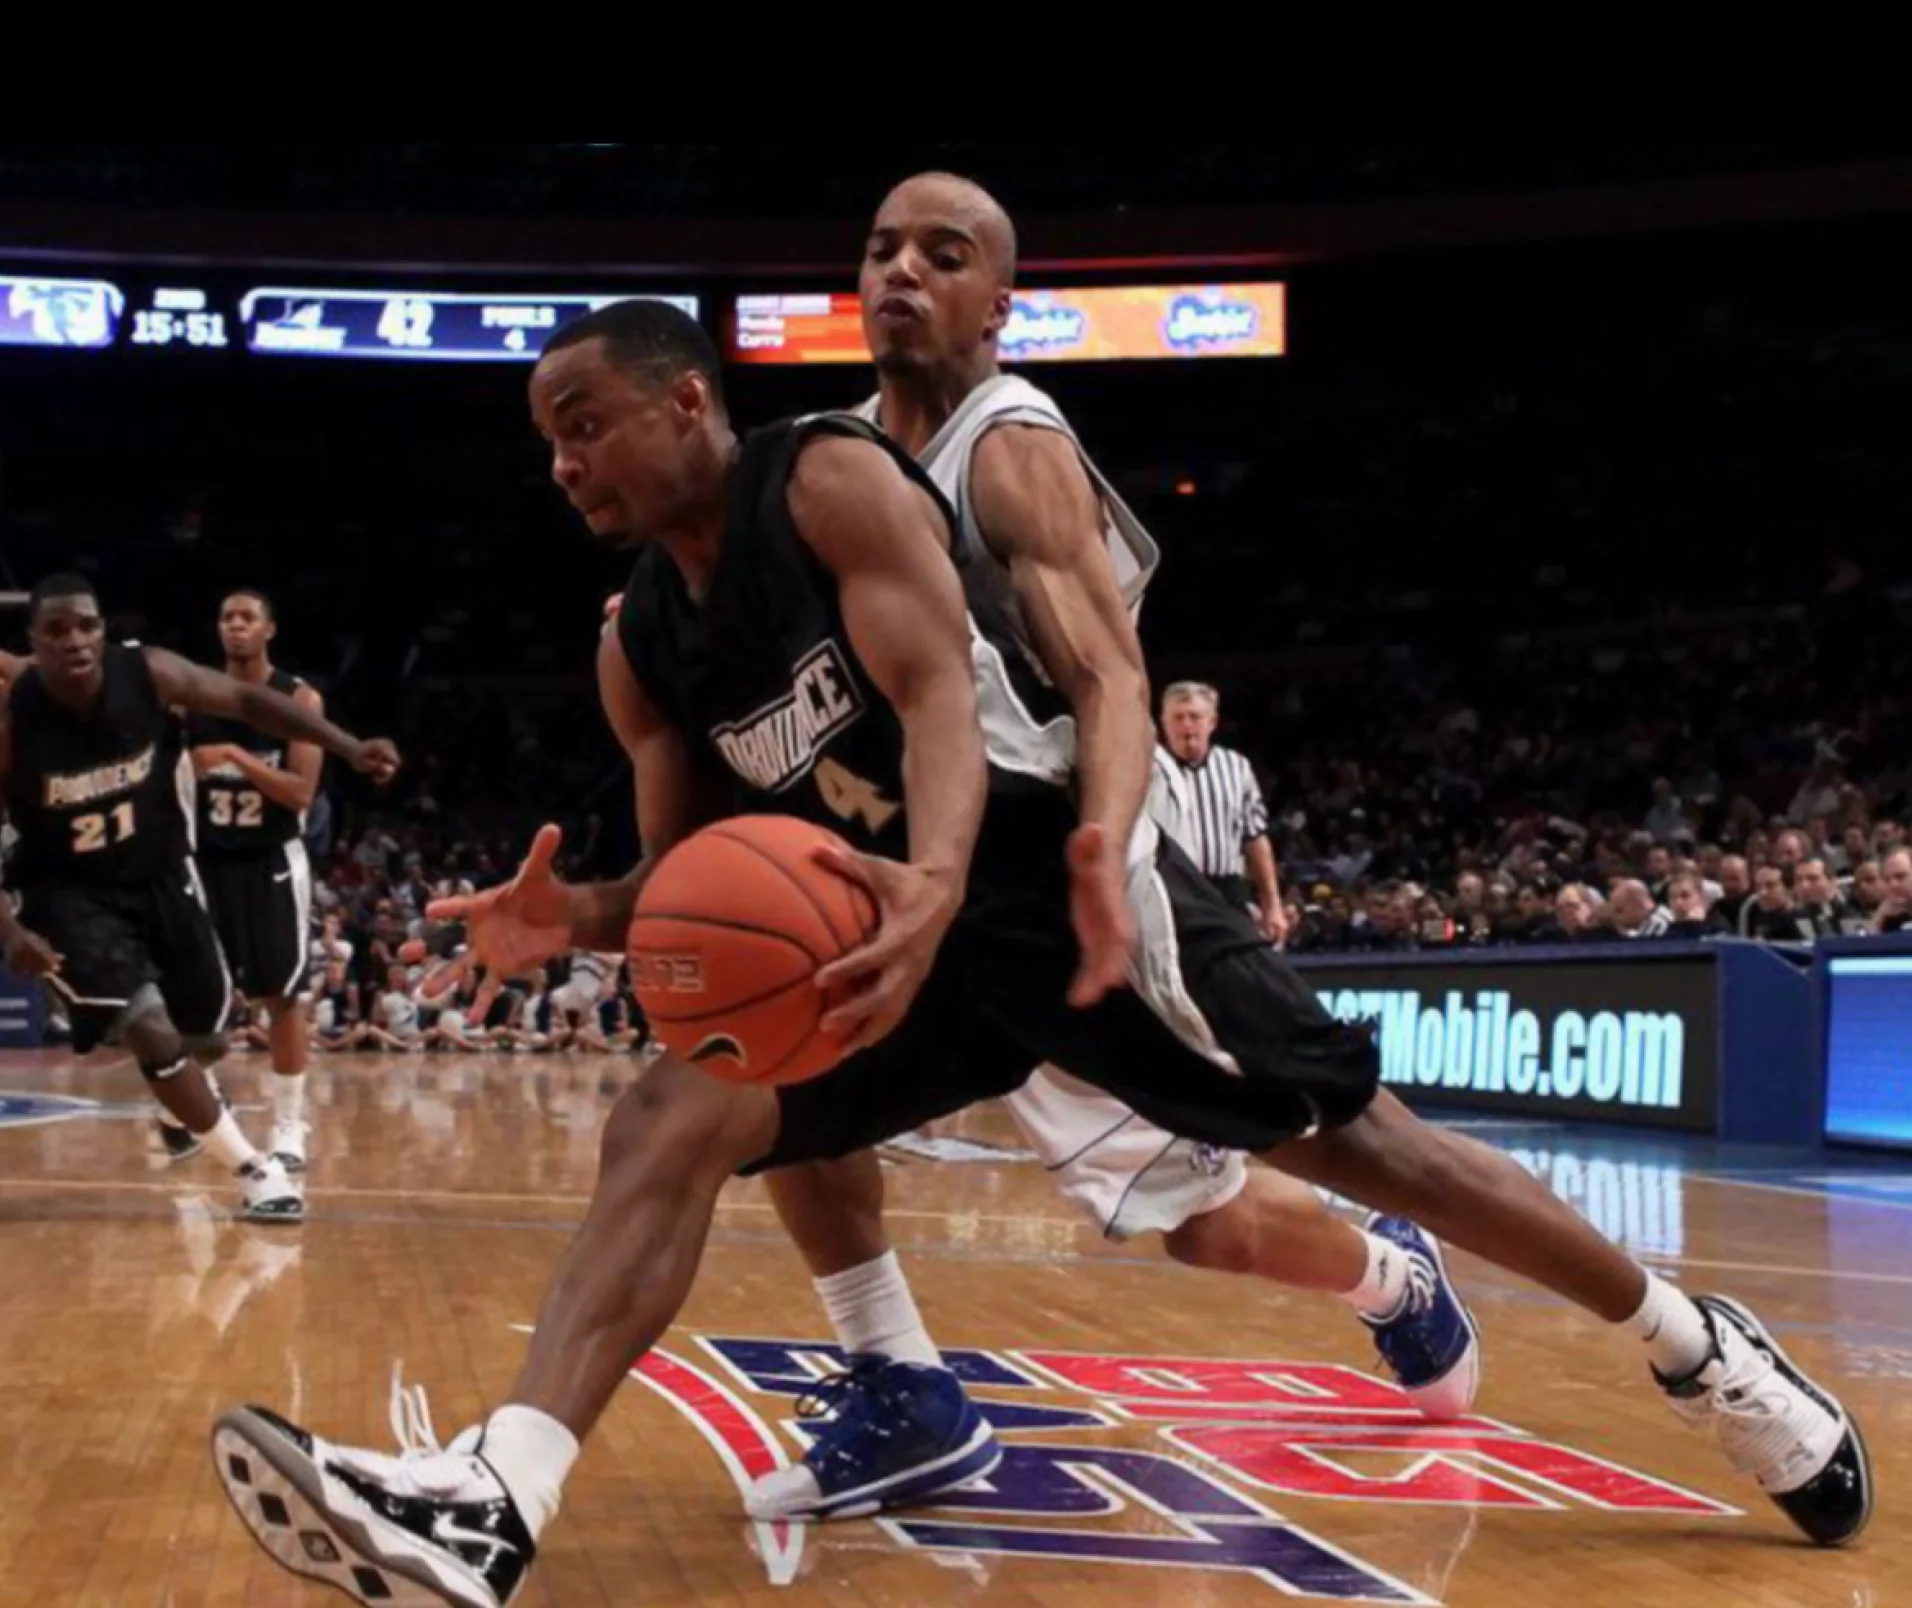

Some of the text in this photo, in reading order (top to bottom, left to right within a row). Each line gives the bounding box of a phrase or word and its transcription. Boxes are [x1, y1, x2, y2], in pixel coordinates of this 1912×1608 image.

[131, 310, 228, 346] 15:51
[377, 299, 434, 347] 42
[208, 789, 264, 826] 32
[814, 756, 903, 835] 4
[70, 802, 136, 852] 21
[1316, 990, 1683, 1107] Mobile.com
